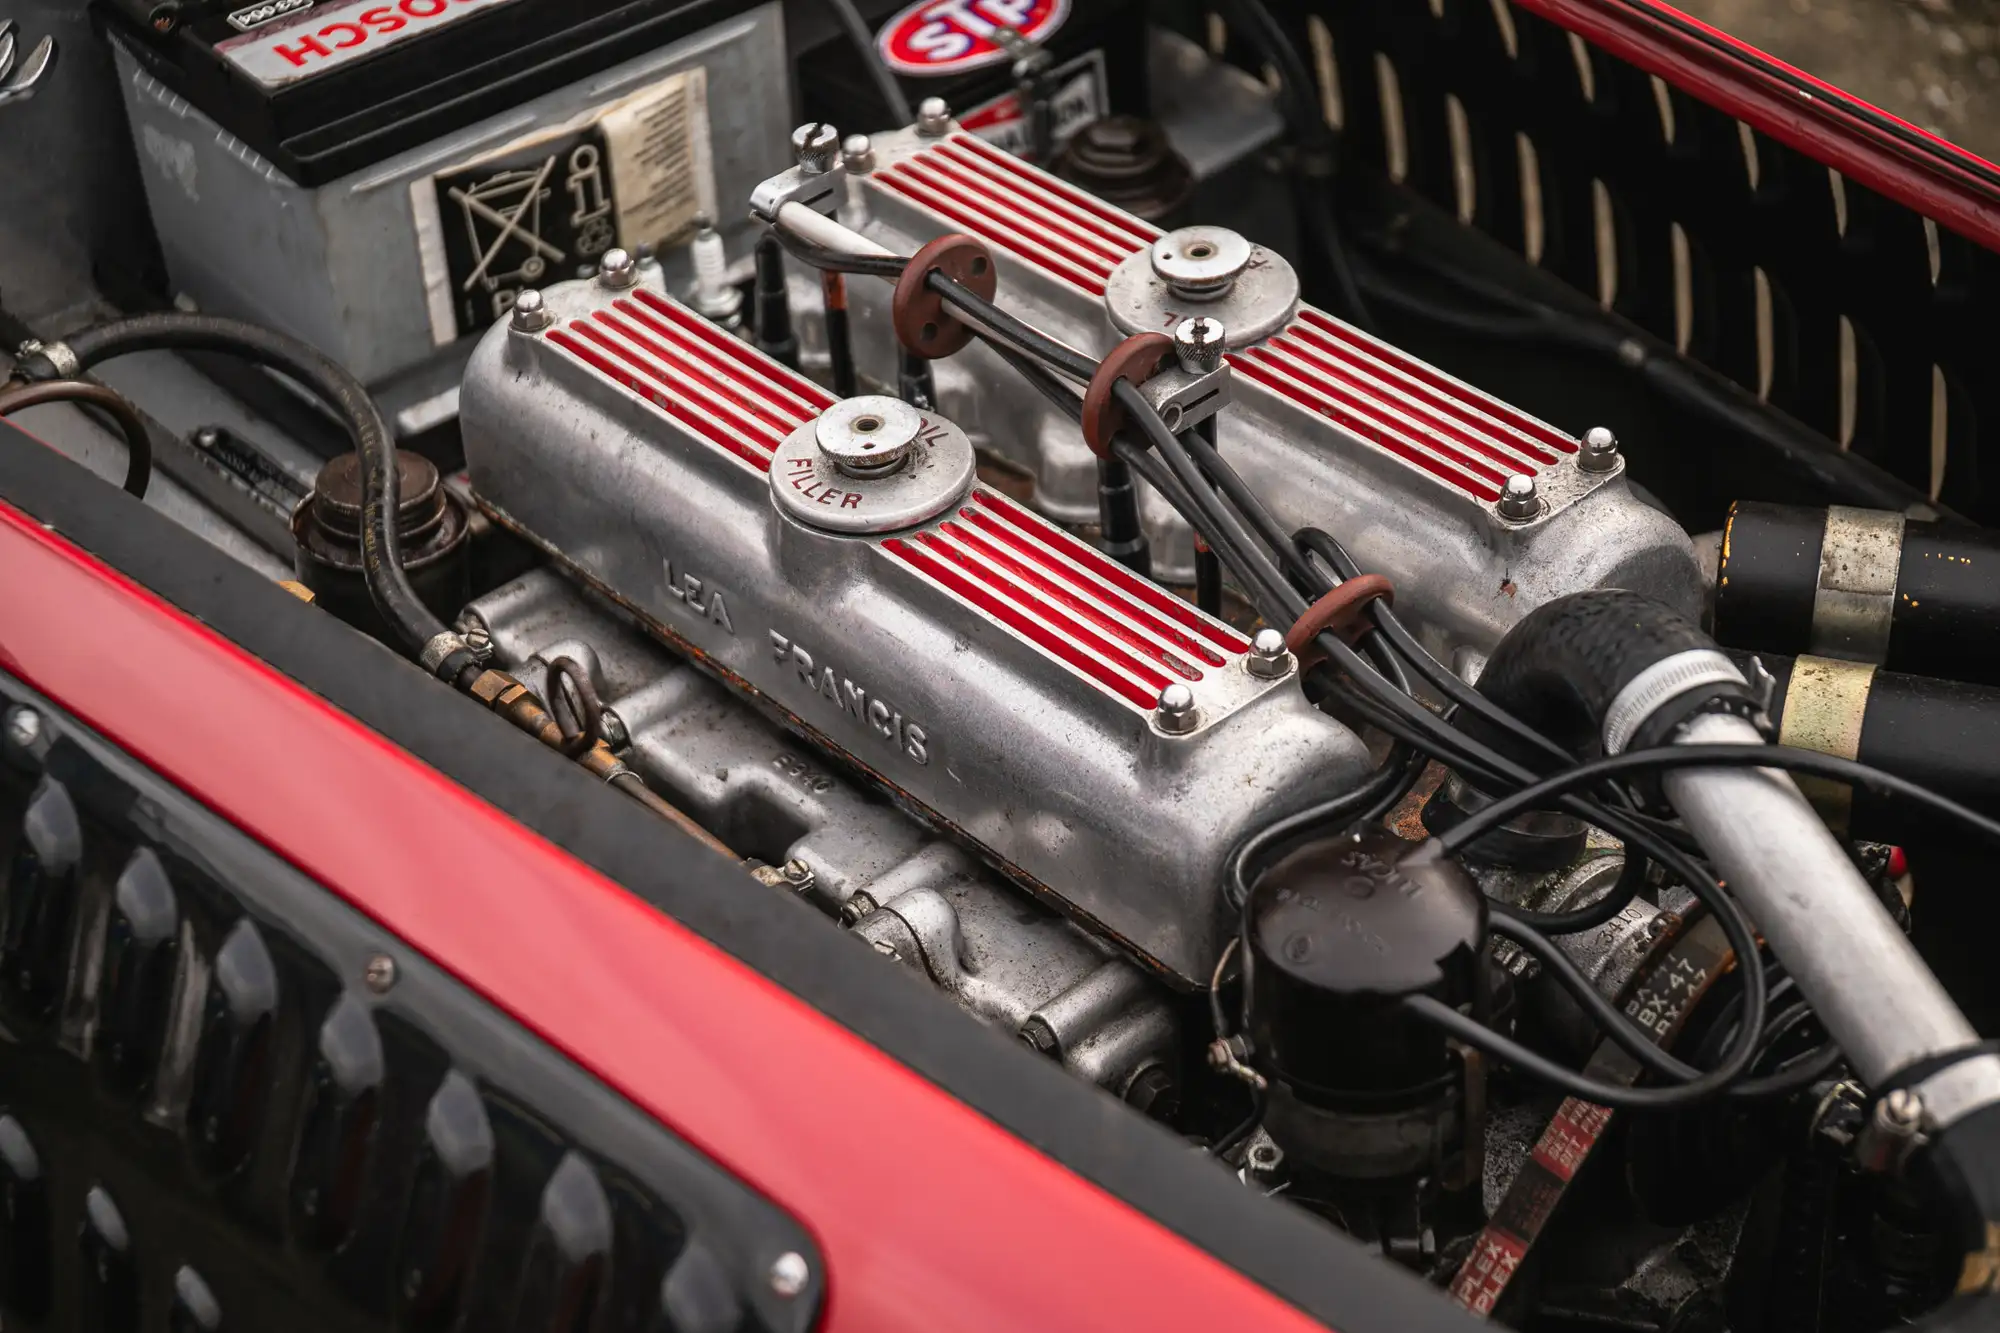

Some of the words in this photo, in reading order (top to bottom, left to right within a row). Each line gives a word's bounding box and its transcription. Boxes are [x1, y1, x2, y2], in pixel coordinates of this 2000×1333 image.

[272, 0, 472, 67] OSCH
[907, 0, 1035, 60] STP
[786, 457, 863, 509] FILLER
[661, 556, 735, 635] LEA
[768, 627, 929, 766] FRANCIS
[1635, 955, 1694, 1028] BX-47
